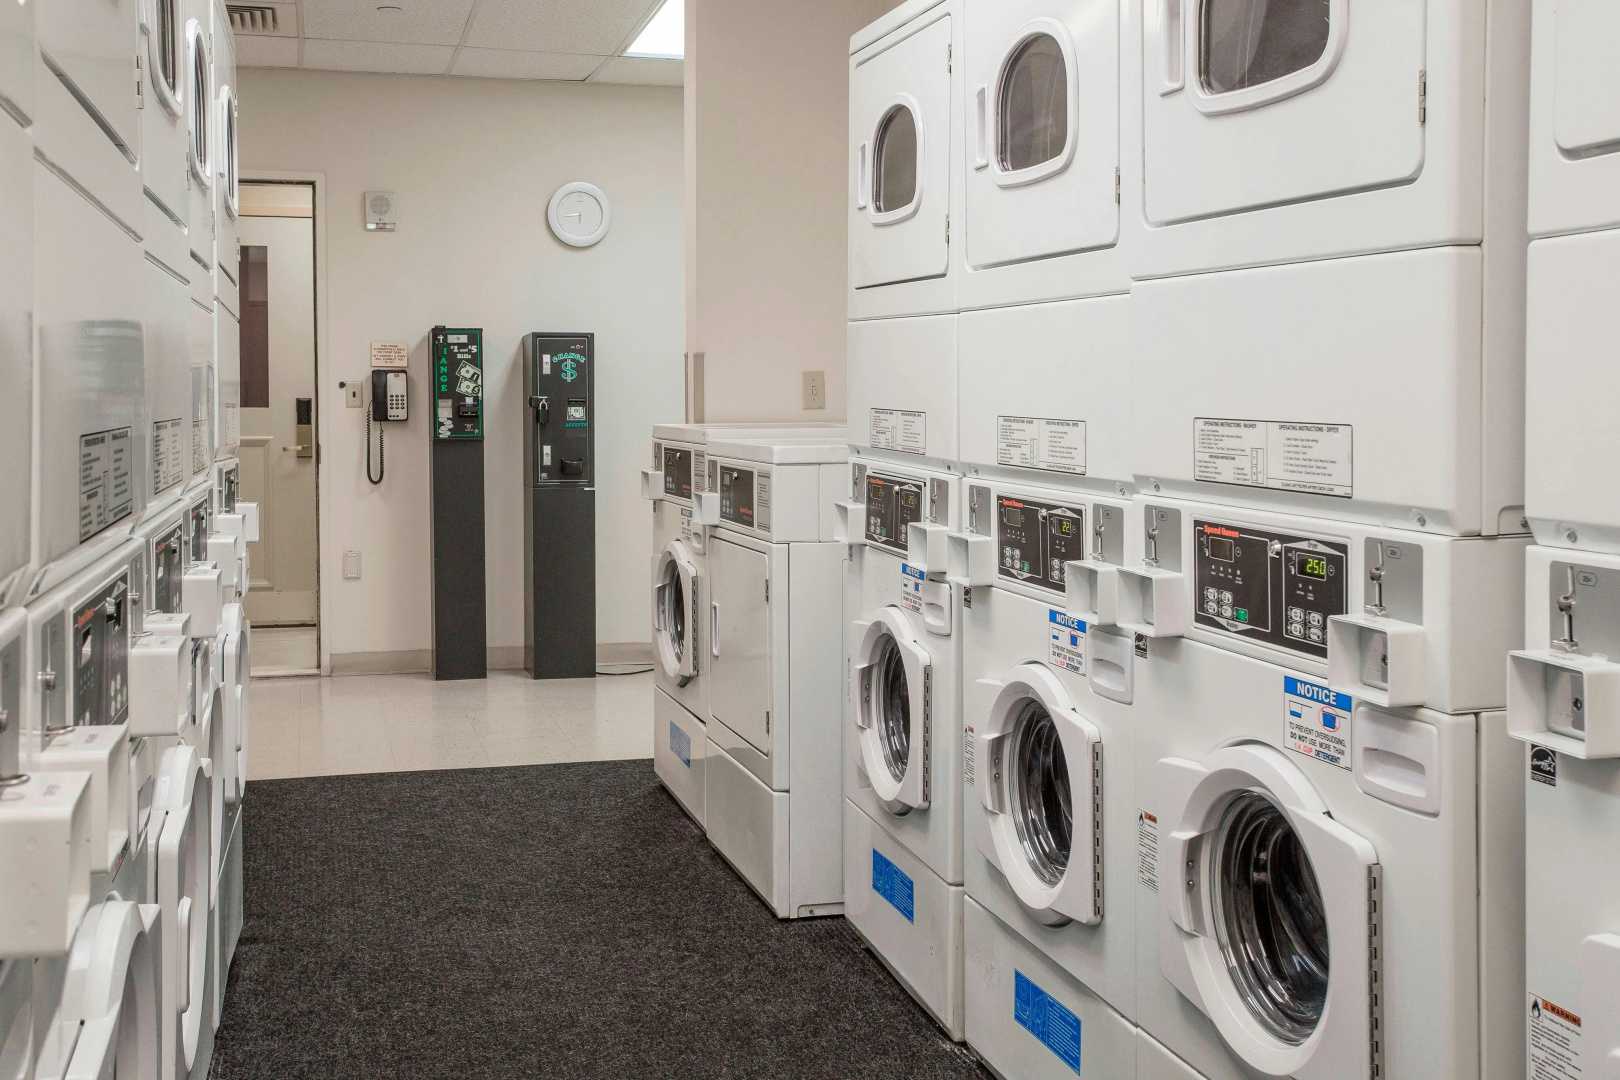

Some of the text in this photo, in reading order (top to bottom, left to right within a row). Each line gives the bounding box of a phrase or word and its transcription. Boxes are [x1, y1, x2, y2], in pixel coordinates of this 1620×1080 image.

[552, 352, 586, 363] CHANGE
[1299, 425, 1324, 433] INSTRUCTIONS
[1204, 524, 1239, 538] Speed Queen
[1307, 540, 1319, 550] Dryer
[1306, 558, 1326, 575] 250
[1056, 613, 1078, 629] NOTICE
[1297, 681, 1337, 705] NOTICE
[1289, 721, 1294, 730] TO
[1295, 723, 1314, 736] PREVENT
[1290, 731, 1345, 757] DO NOT USE MORE THAN
[1303, 745, 1313, 754] CUP
[1314, 749, 1341, 764] DETERGENT
[1551, 1006, 1581, 1027] WARNING
